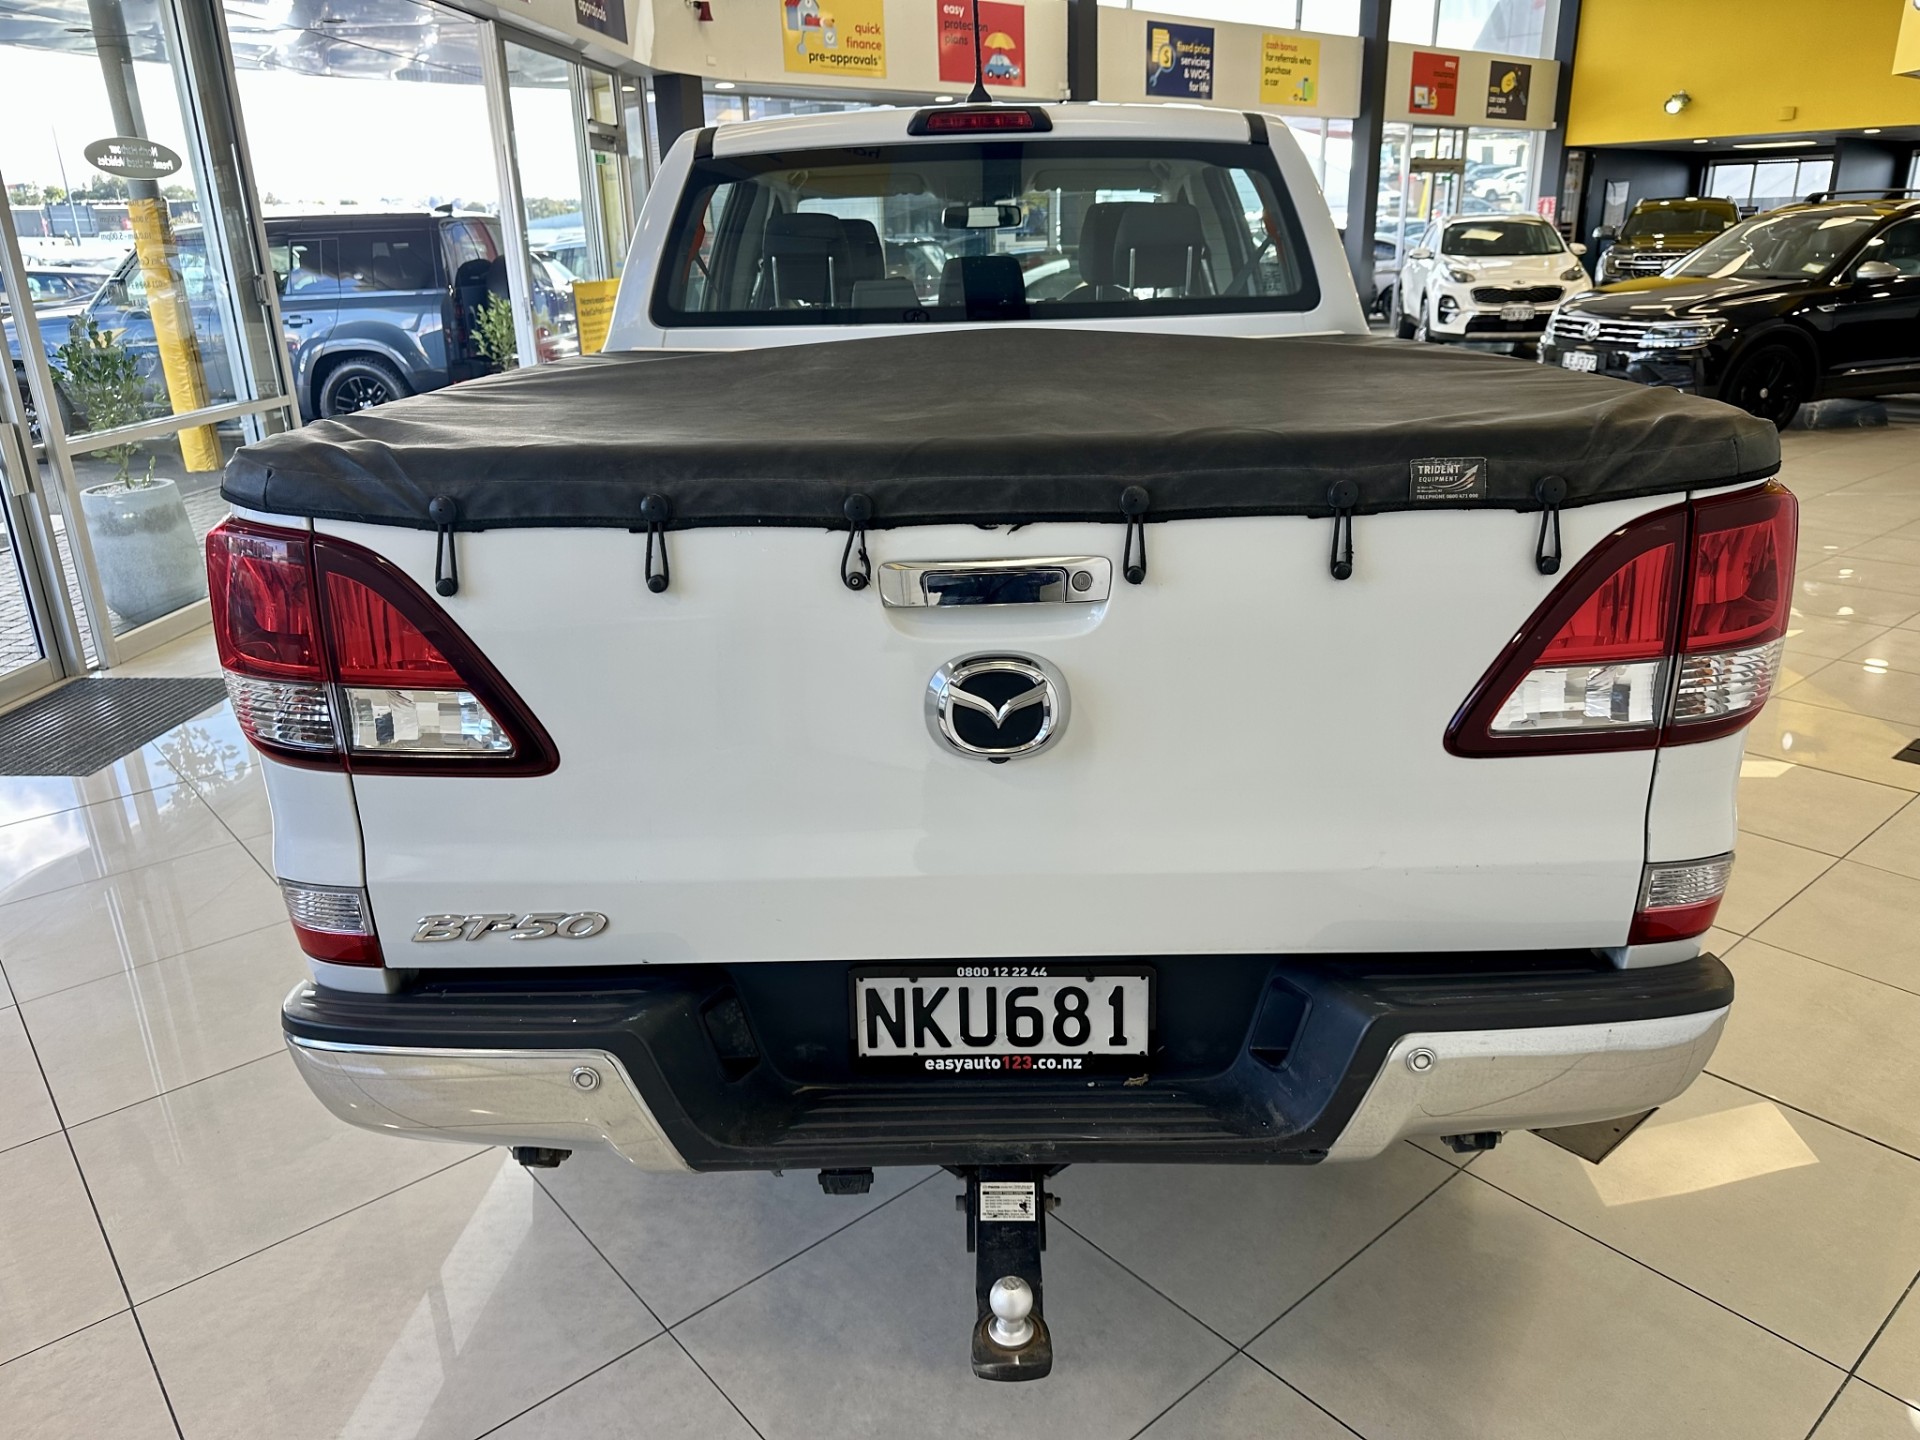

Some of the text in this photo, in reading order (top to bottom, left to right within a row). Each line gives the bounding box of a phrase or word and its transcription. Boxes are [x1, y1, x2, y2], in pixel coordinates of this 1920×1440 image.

[943, 4, 965, 18] easy
[854, 22, 881, 36] quick
[846, 37, 882, 50] finance
[944, 33, 969, 46] plans
[1194, 44, 1211, 54] price
[1181, 56, 1211, 70] servicing
[1265, 51, 1274, 62] for
[1184, 67, 1210, 80] & WOFs
[1188, 81, 1210, 93] for life
[1418, 464, 1460, 474] TRIDENT
[1418, 475, 1458, 483] EQUIPMENT
[411, 911, 609, 942] BT-50
[956, 966, 1047, 977] 0800 12 22 44
[865, 985, 1128, 1048] NKU681
[924, 1055, 1082, 1073] easyauto123.co.nz
